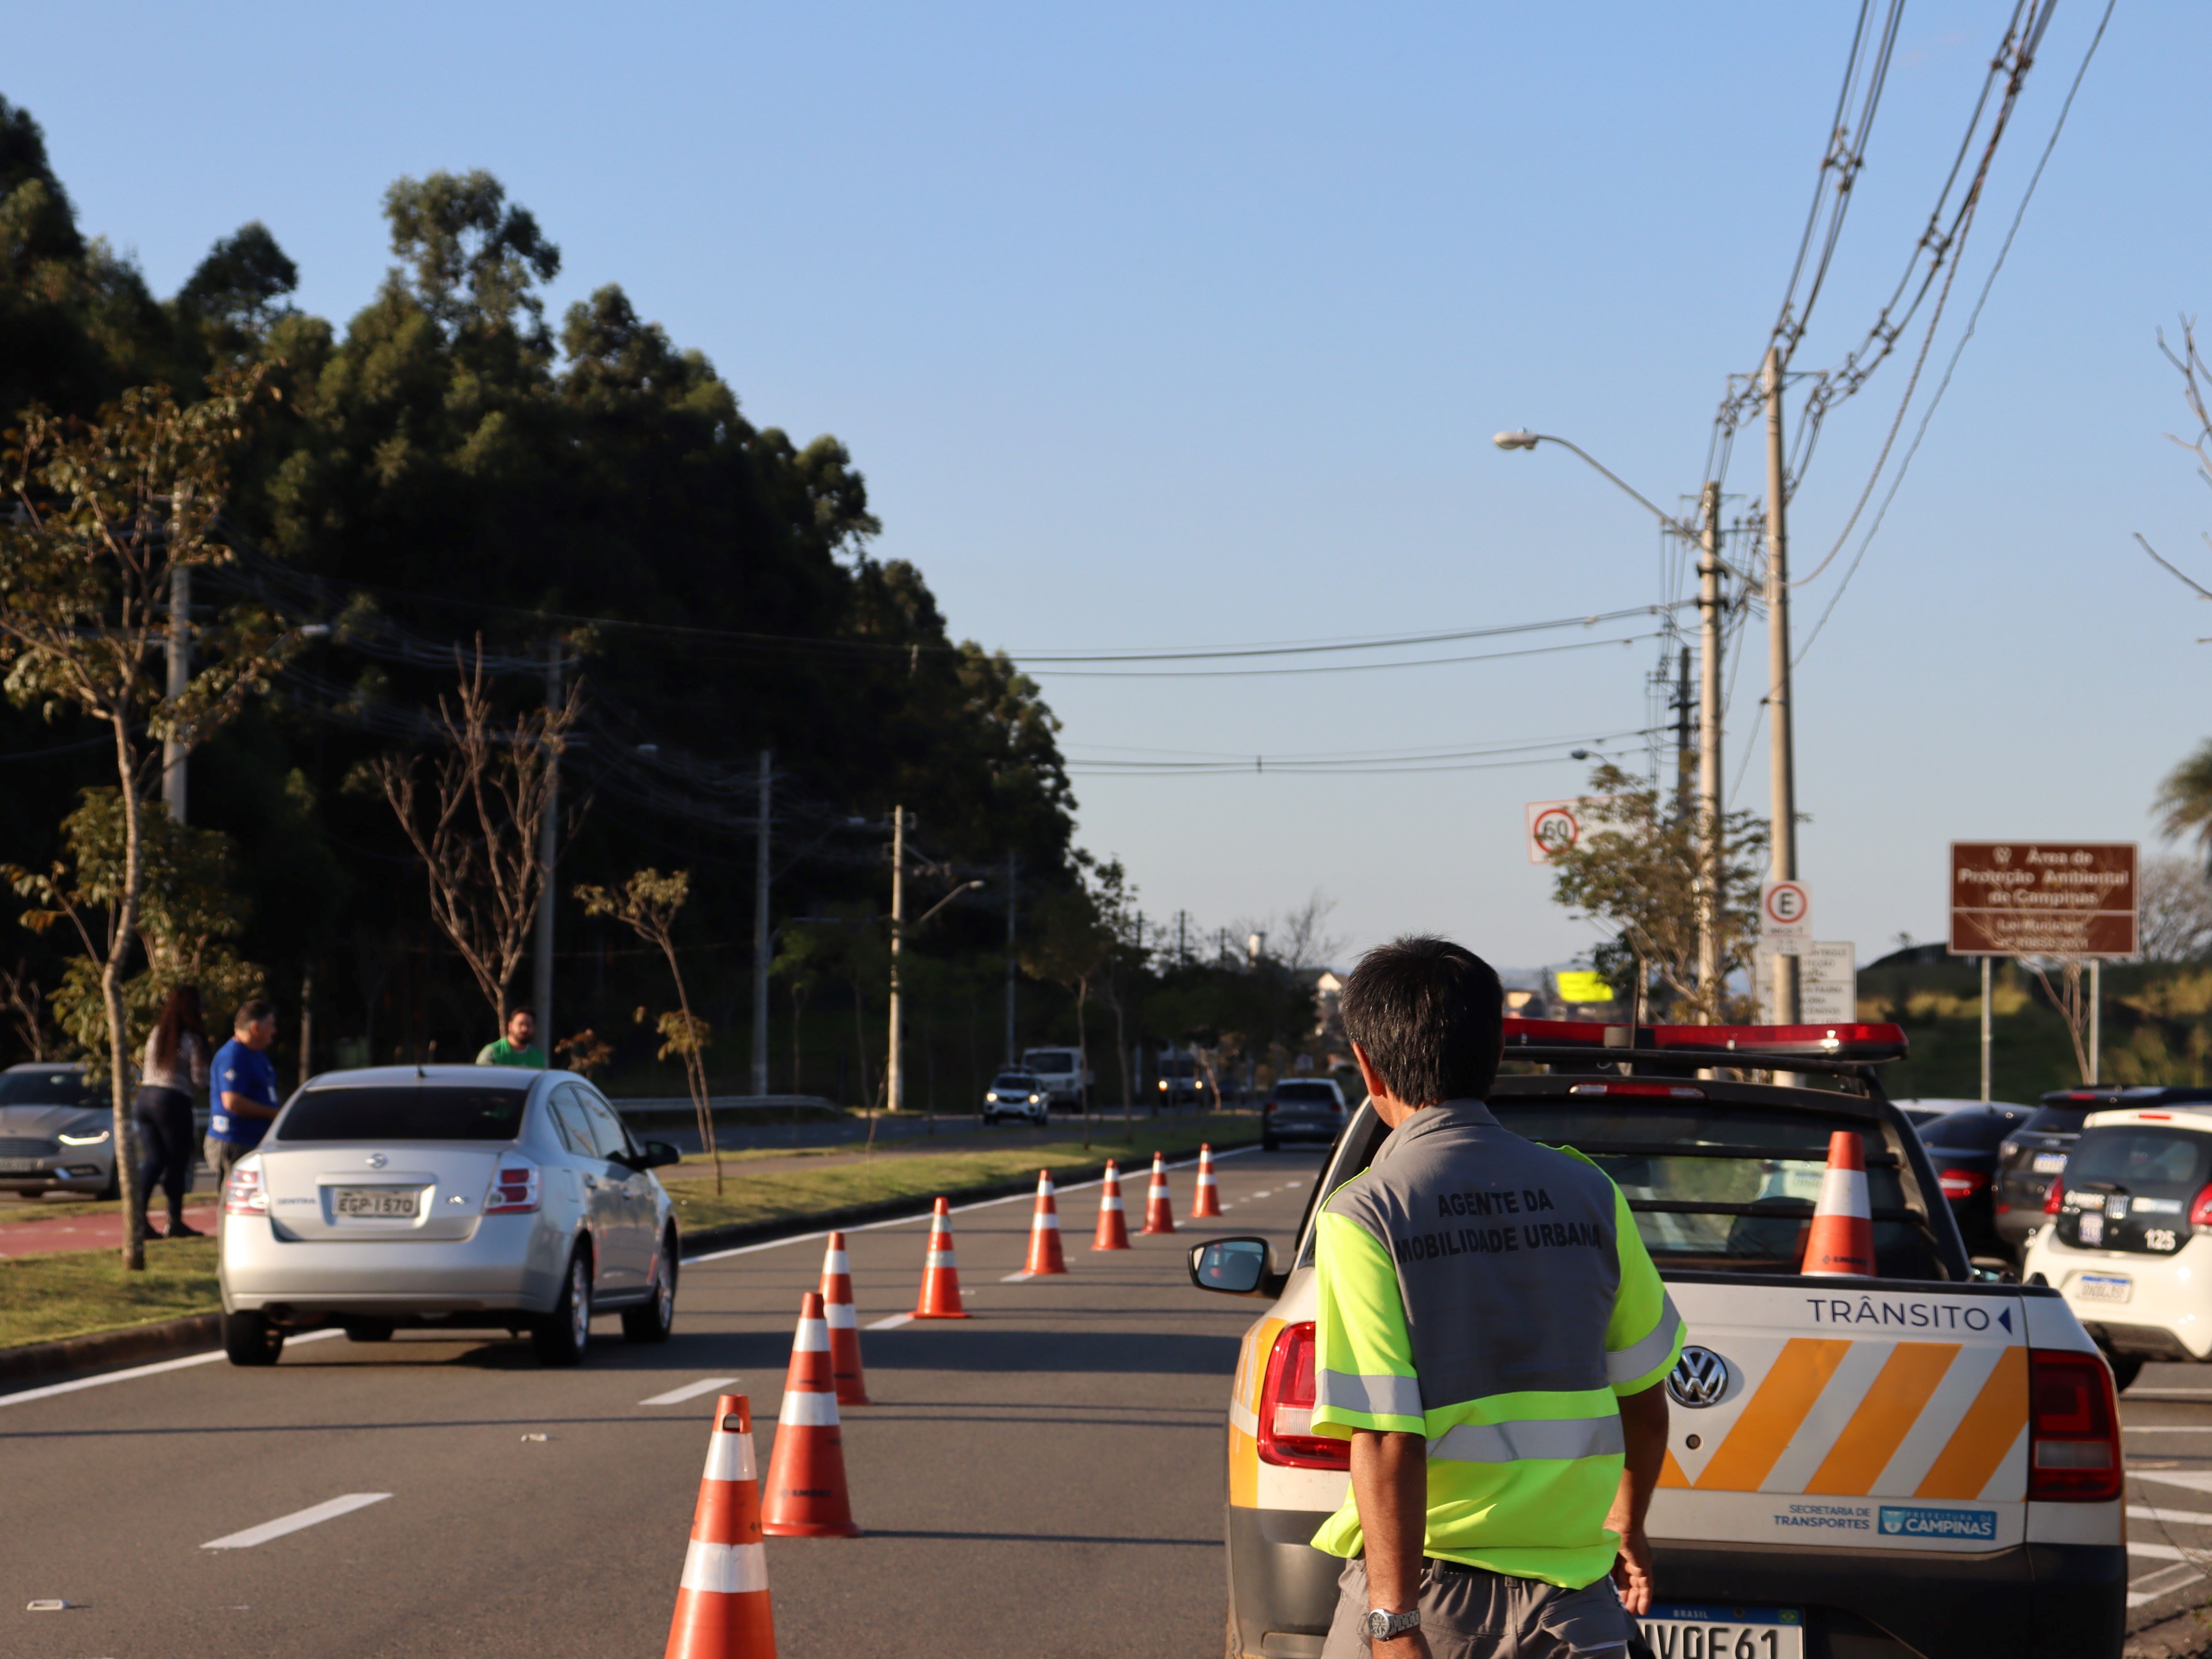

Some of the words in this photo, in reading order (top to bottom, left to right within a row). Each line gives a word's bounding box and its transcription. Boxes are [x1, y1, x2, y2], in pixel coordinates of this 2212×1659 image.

[1544, 820, 1568, 839] 60
[2070, 850, 2093, 866] de
[2042, 869, 2129, 885] Ambiental
[1780, 893, 1794, 914] E
[2012, 888, 2099, 906] Campinas
[1438, 1191, 1519, 1218] AGENTE
[1523, 1189, 1554, 1211] DA
[1395, 1227, 1519, 1264] MOBILIDADE
[1524, 1222, 1602, 1250] URBANA
[2144, 1229, 2175, 1251] 125
[1807, 1296, 1990, 1331] TRÂNSITO
[1790, 1505, 1854, 1516] SECRETARIA
[1856, 1508, 1872, 1517] DE
[1774, 1515, 1870, 1529] TRANSPORTES
[1905, 1519, 1992, 1536] CAMPINAS
[1673, 1609, 1708, 1619] BRASIL
